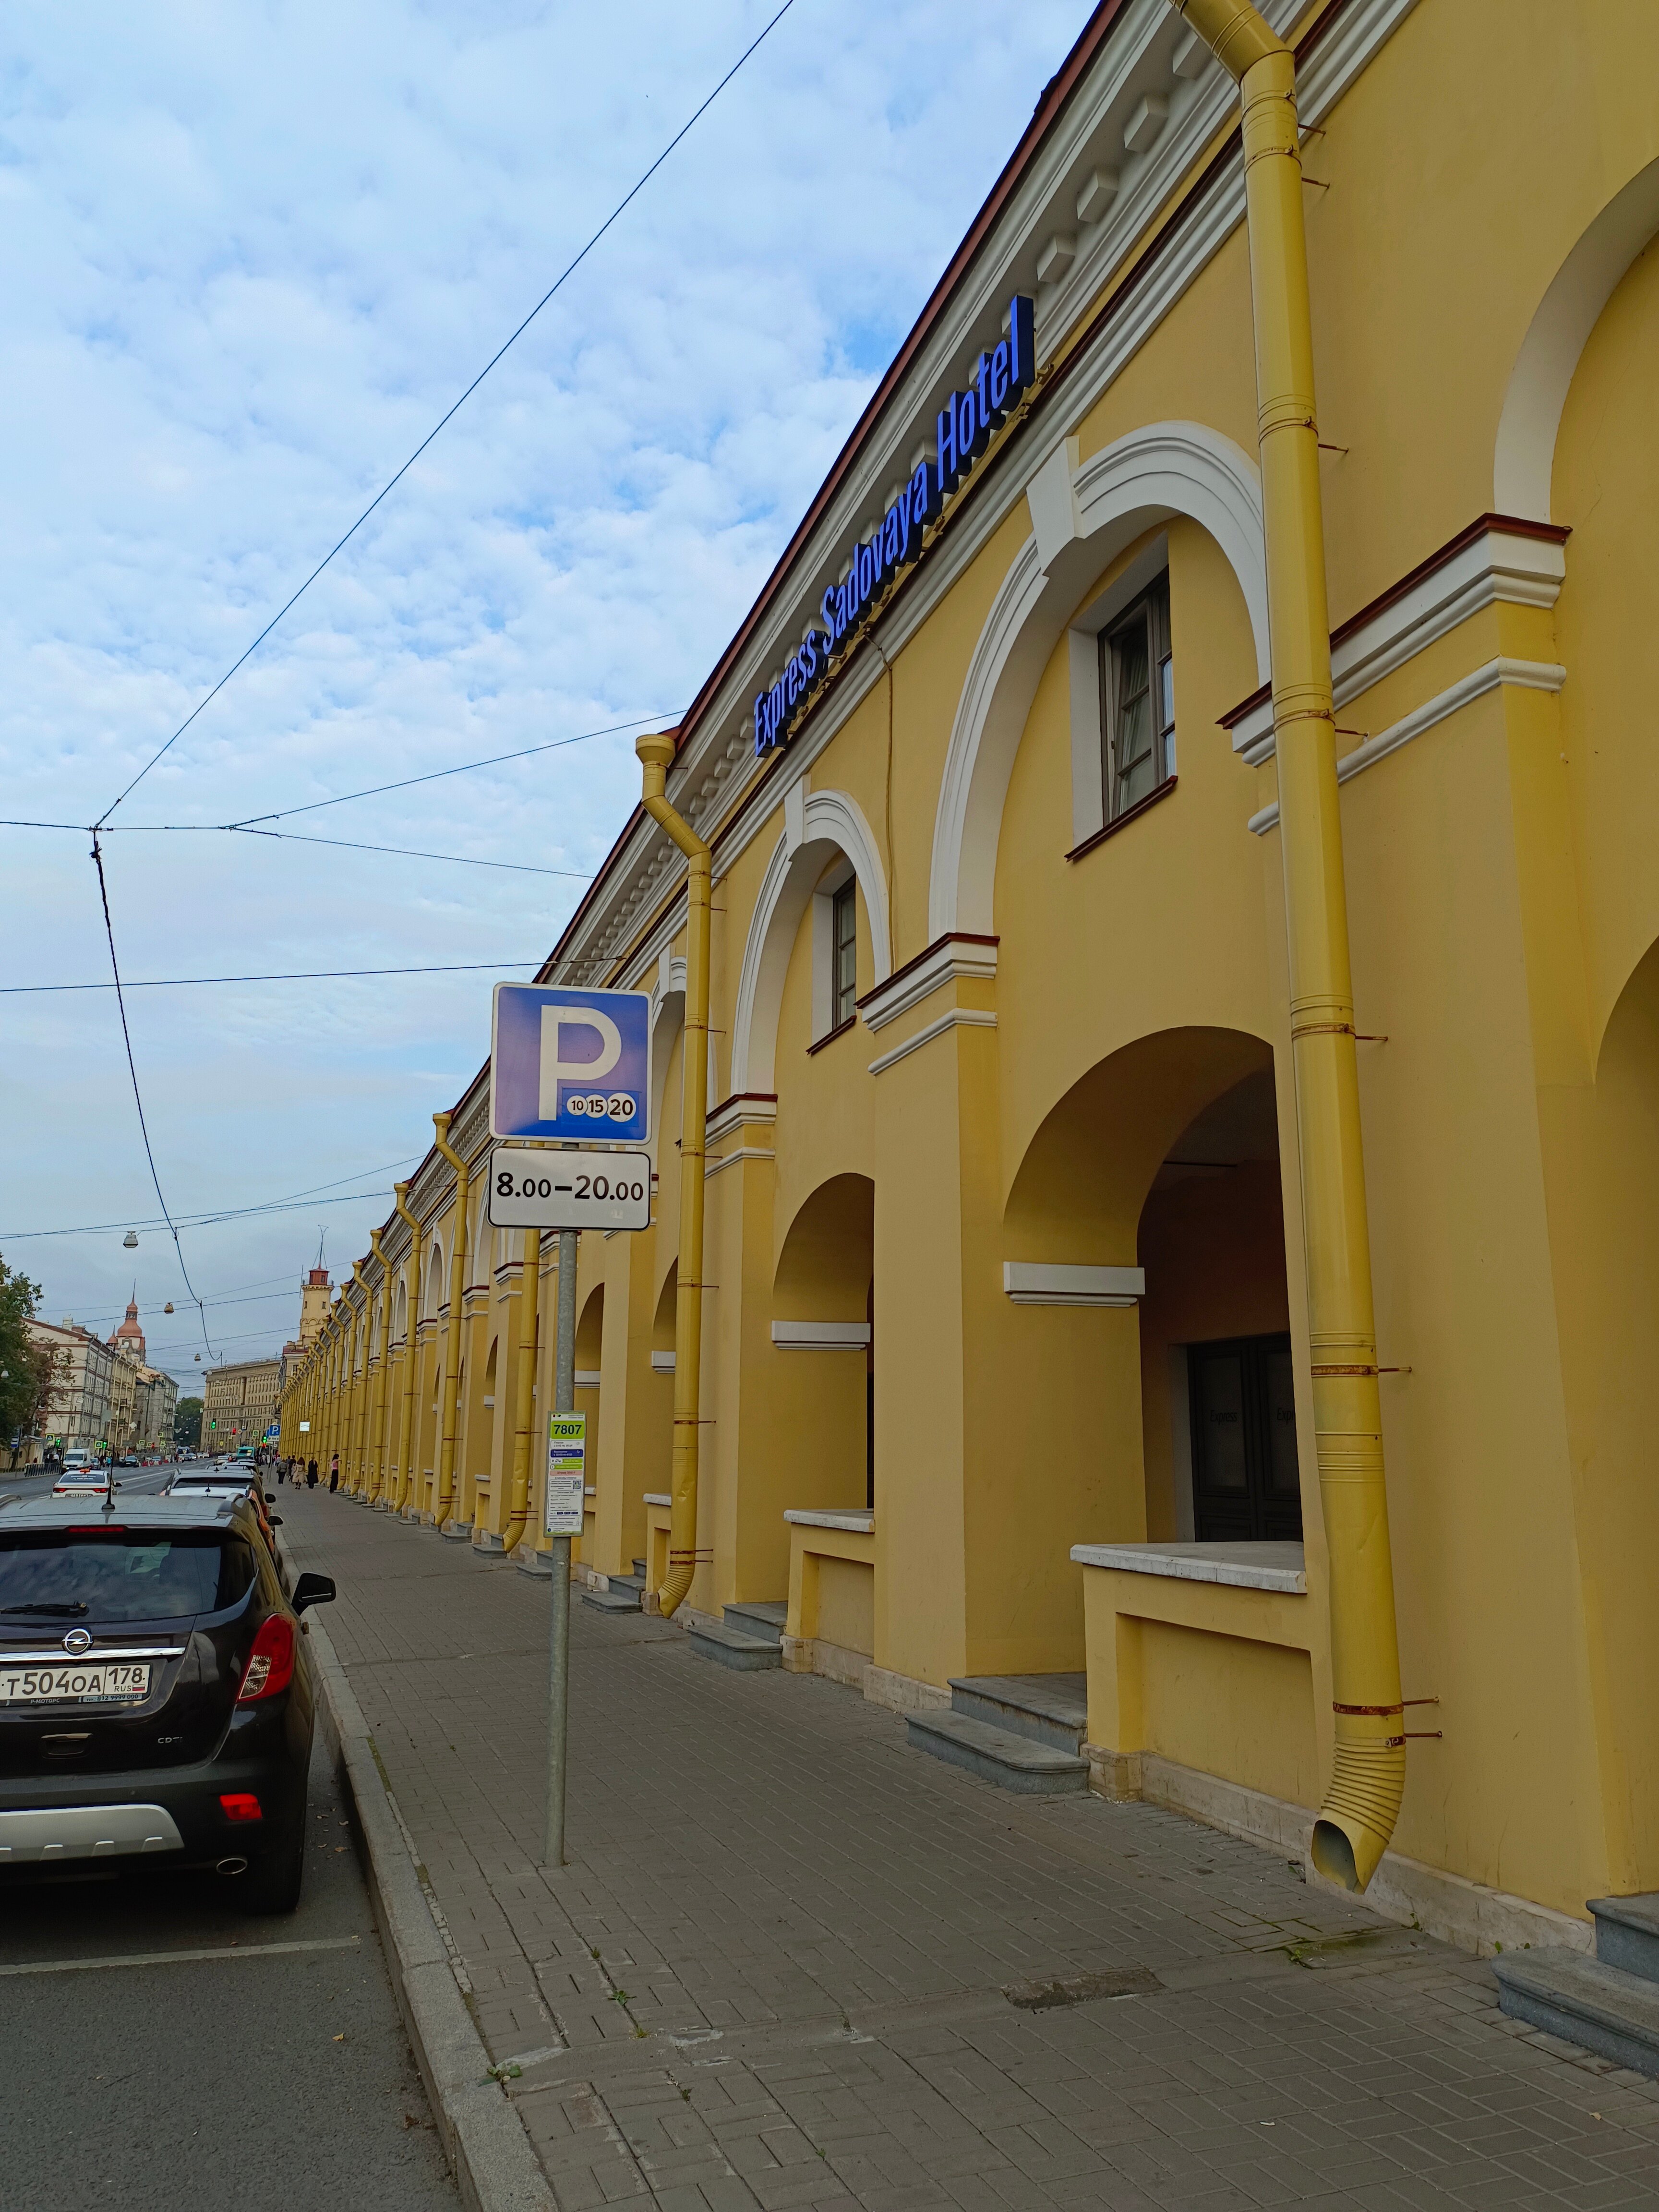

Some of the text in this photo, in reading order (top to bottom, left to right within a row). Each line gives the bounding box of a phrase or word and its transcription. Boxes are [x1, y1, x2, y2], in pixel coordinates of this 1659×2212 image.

[755, 294, 1020, 757] Express Sadovaya Hotel
[539, 1004, 622, 1121] P
[571, 1099, 634, 1116] 10 15 20
[1210, 1409, 1238, 1425] Express
[553, 1424, 582, 1434] 7807
[108, 1667, 143, 1684] 178
